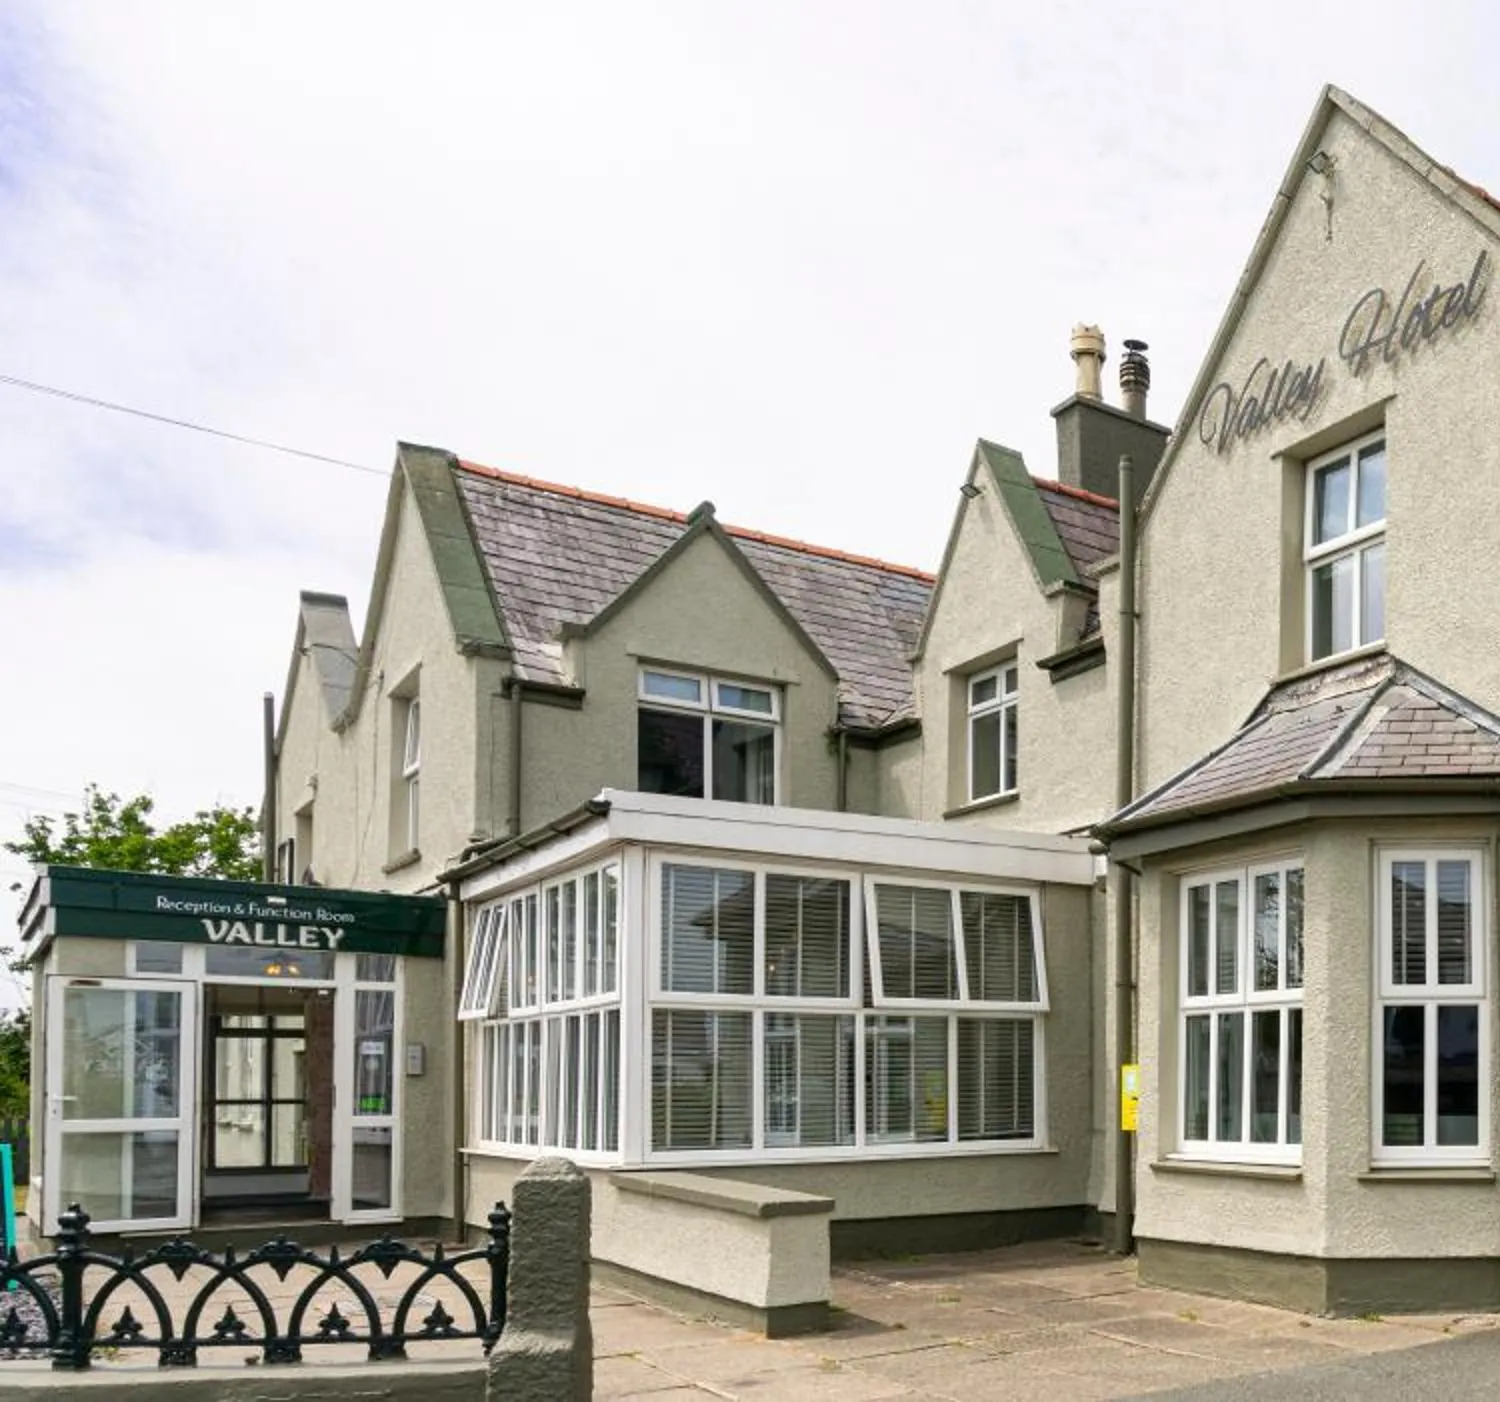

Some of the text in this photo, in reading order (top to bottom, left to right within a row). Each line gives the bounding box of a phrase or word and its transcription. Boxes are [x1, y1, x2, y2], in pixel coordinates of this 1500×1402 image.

[1201, 249, 1486, 455] Valley Hotel
[156, 895, 355, 923] Reception & Function Room
[201, 918, 345, 949] VALLEY
